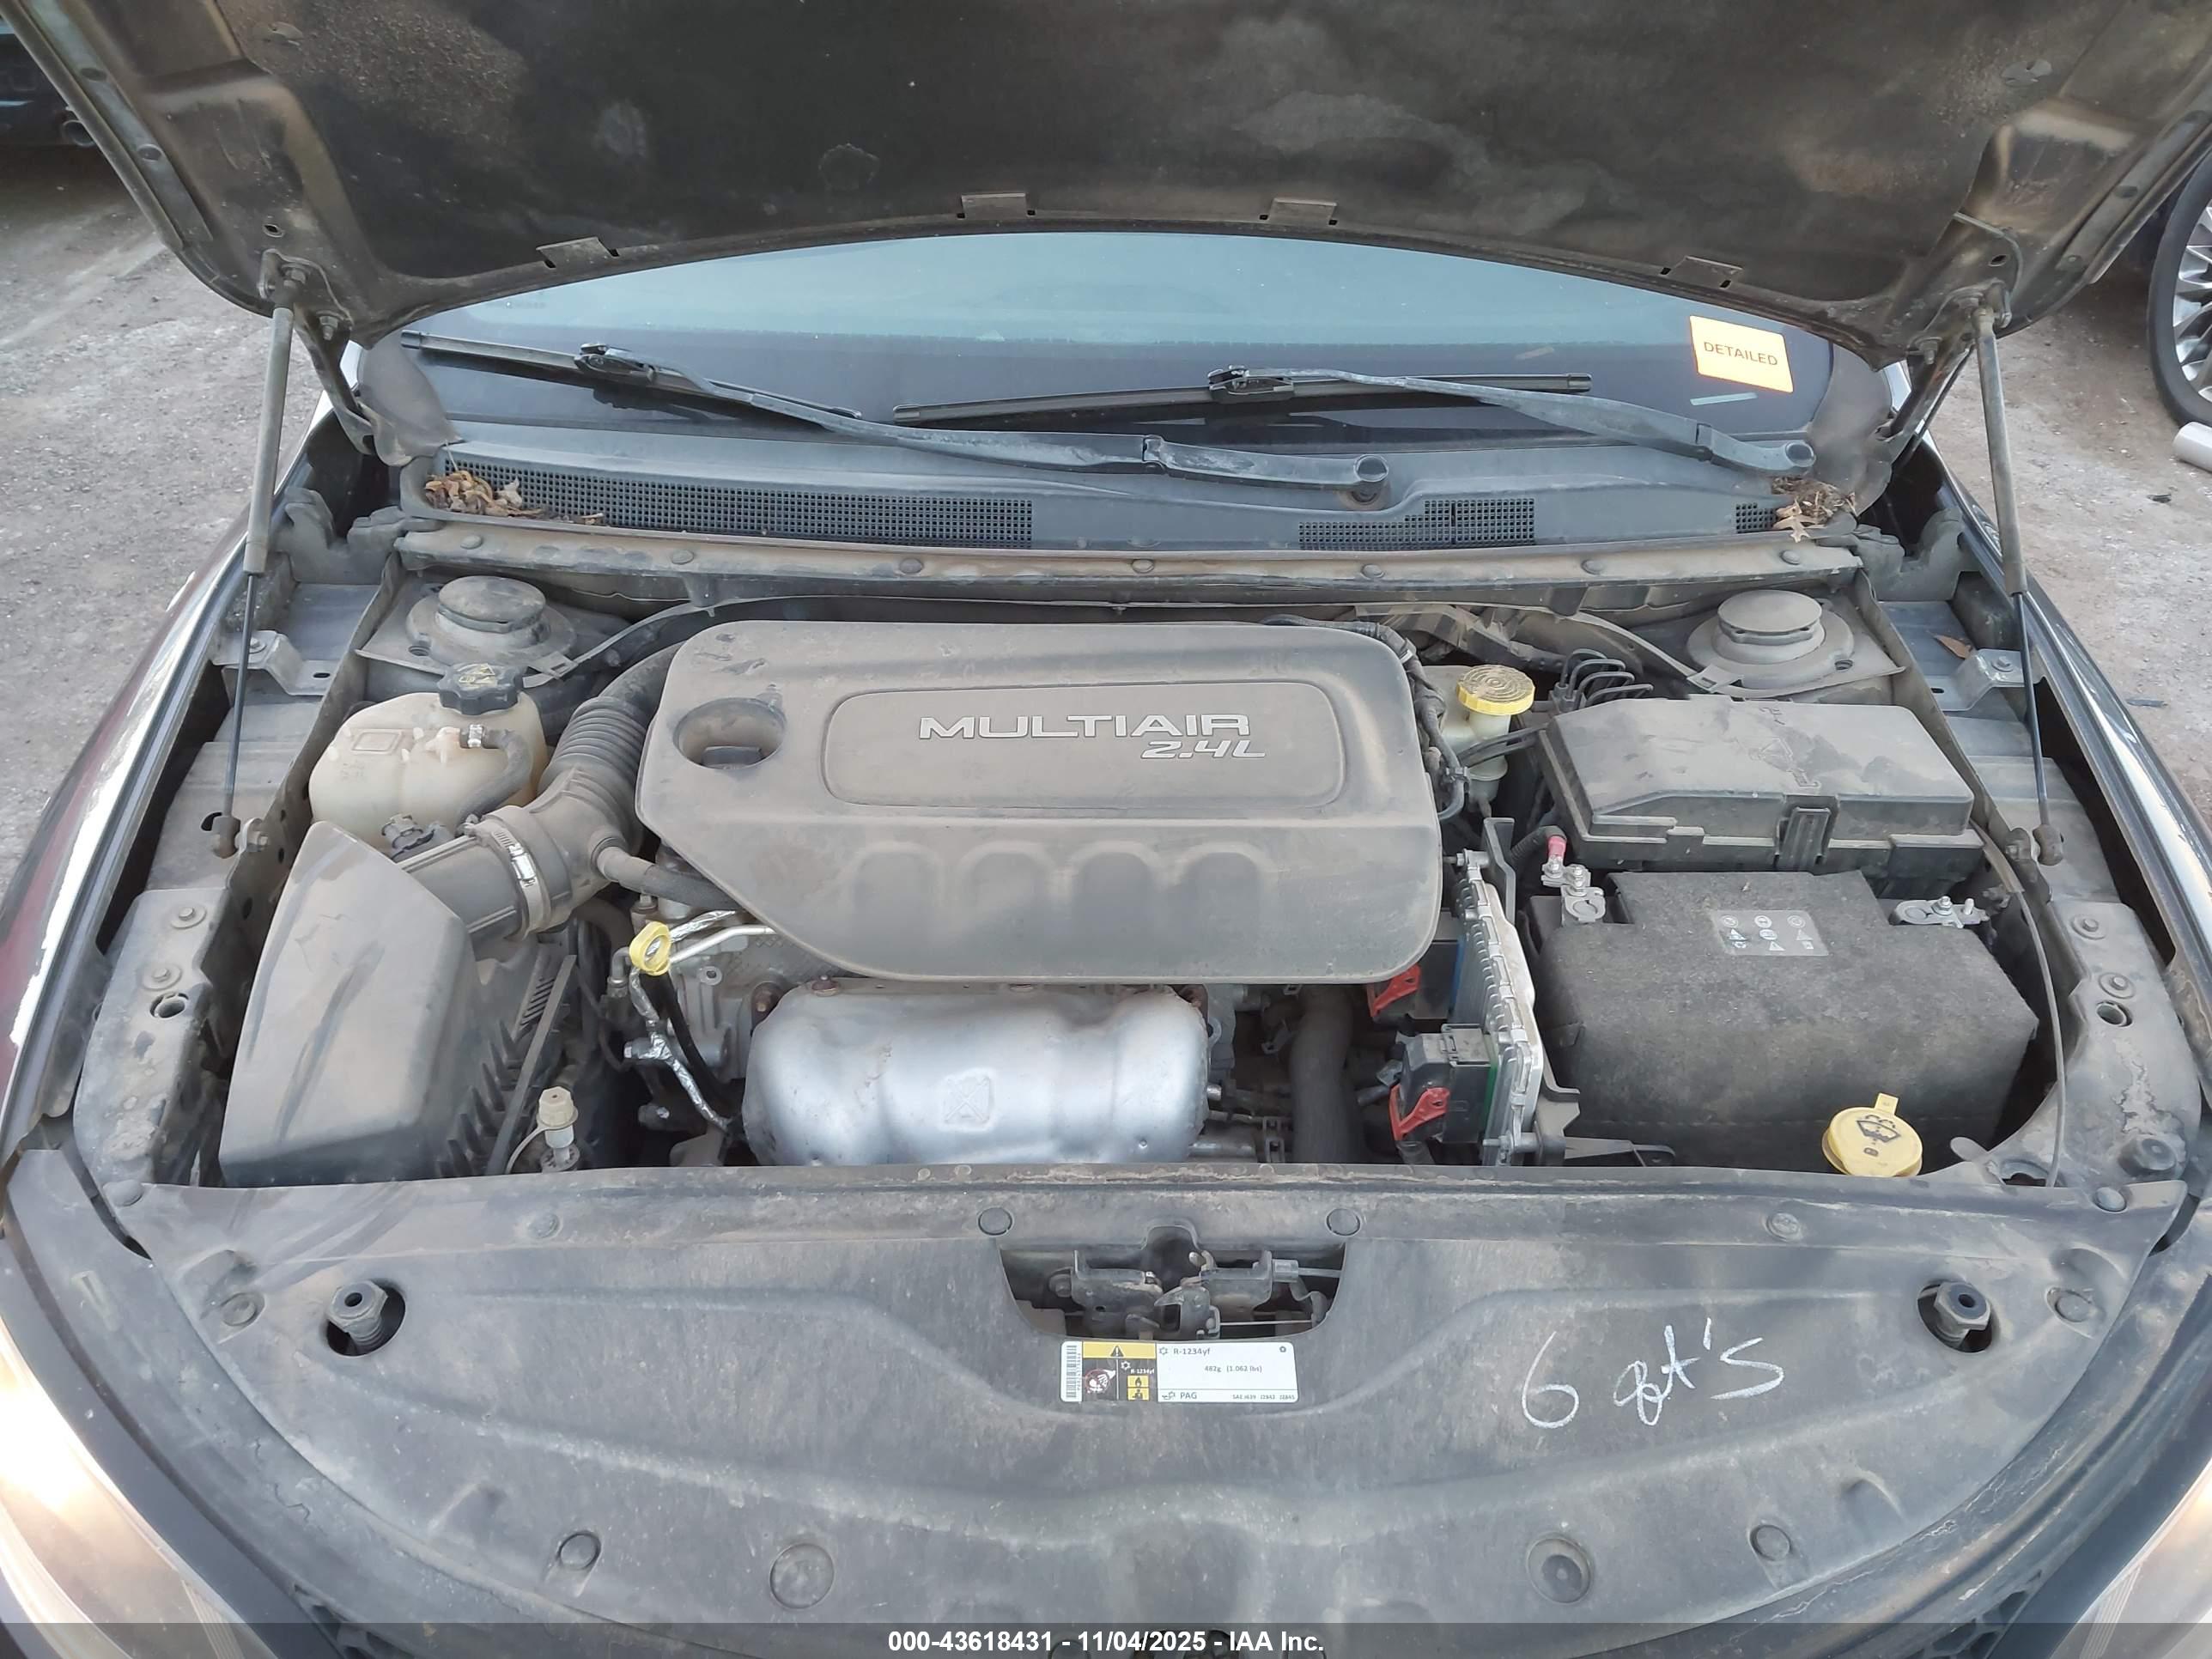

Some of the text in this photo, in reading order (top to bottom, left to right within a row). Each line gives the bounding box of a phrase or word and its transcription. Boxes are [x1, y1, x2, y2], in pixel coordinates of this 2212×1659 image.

[1704, 342, 1778, 366] DETAILED
[918, 714, 1251, 738] MULTIAIR
[1140, 739, 1267, 759] 2.4L
[1173, 1347, 1211, 1357] R-1234yf
[1521, 1330, 1580, 1429] 6
